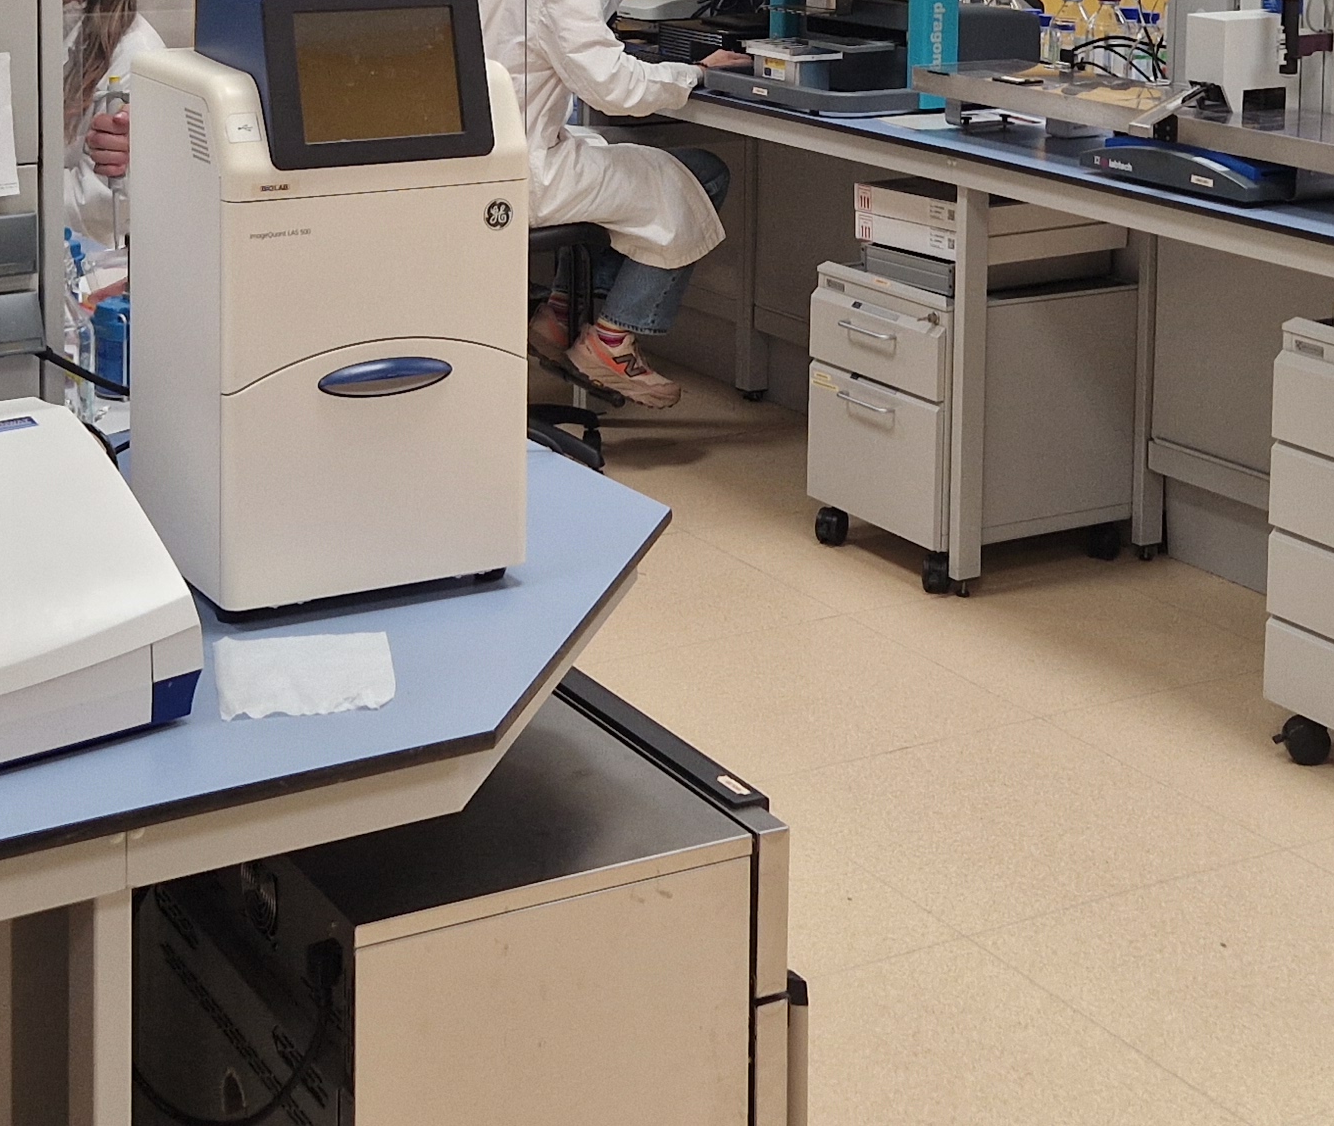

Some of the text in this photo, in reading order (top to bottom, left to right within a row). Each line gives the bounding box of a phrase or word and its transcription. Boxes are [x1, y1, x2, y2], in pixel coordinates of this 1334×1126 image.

[930, 2, 946, 70] dragon
[260, 184, 289, 192] BIOLAB
[249, 230, 286, 240] ImageQuant
